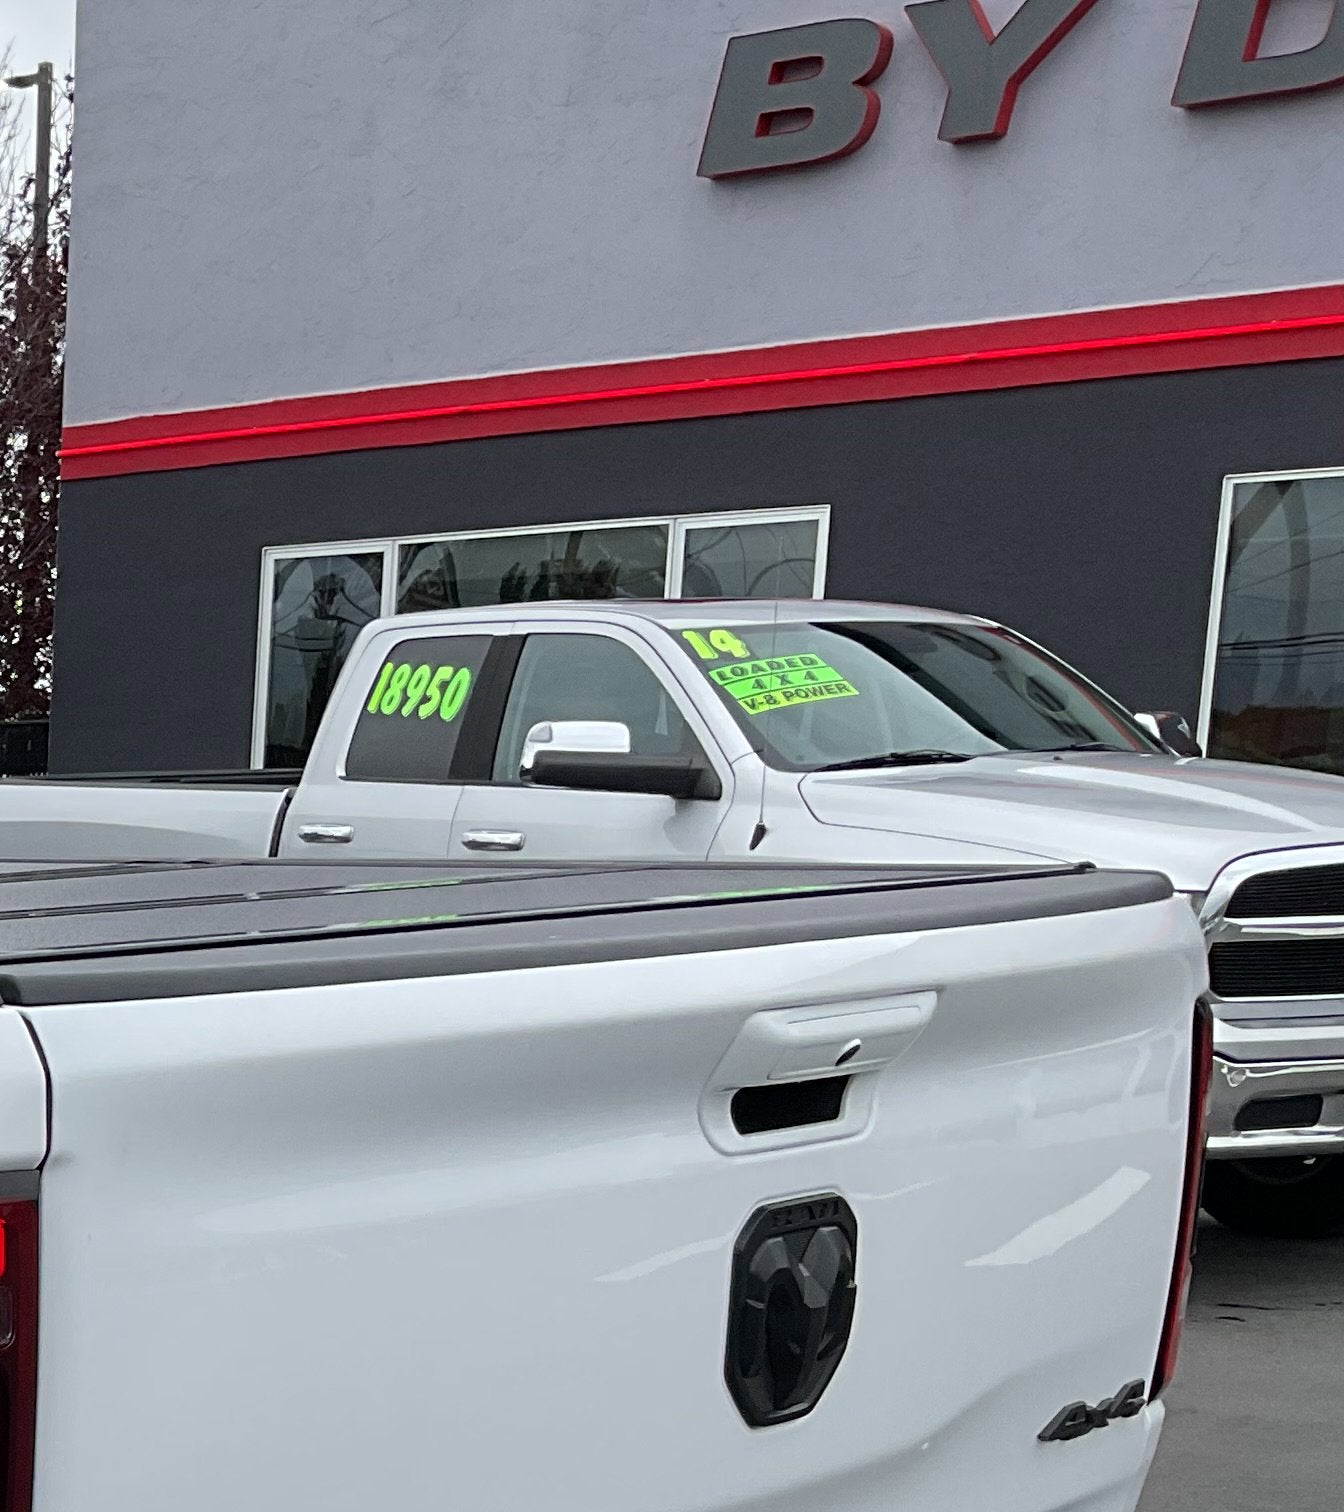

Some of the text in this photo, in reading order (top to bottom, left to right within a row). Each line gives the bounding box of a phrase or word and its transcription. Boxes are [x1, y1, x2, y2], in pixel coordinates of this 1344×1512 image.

[697, 0, 1097, 180] BY
[682, 629, 750, 660] 14
[715, 655, 820, 682] LOADED
[366, 661, 472, 722] 18950
[744, 683, 851, 711] V-8 POWER
